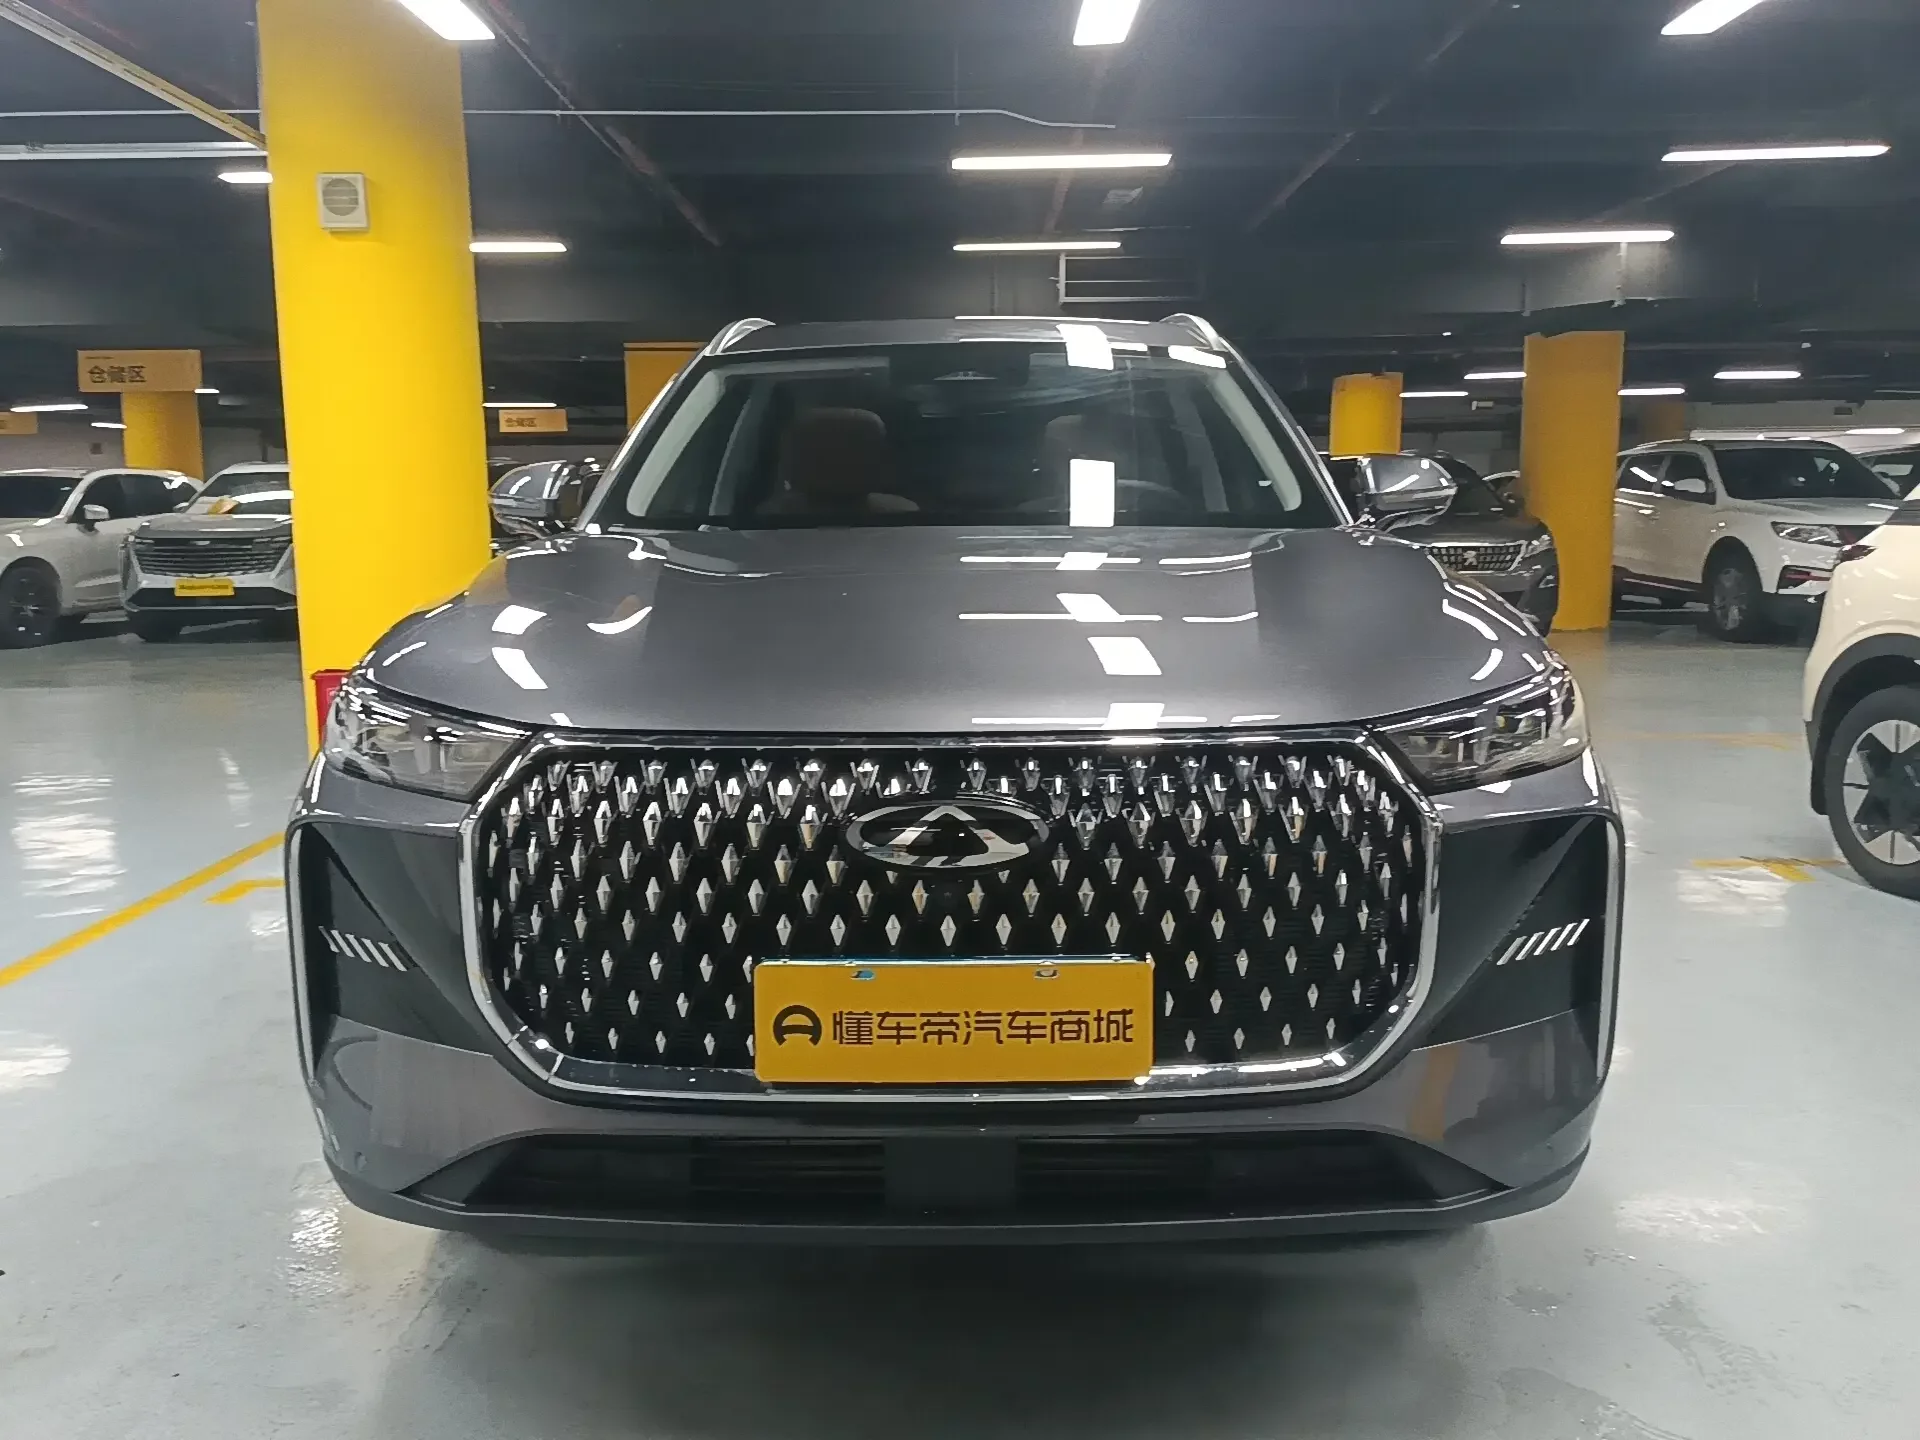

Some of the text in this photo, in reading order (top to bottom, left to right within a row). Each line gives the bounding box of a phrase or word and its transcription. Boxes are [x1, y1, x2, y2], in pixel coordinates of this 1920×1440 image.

[832, 1008, 1134, 1045] 懂车帝汽车商城
